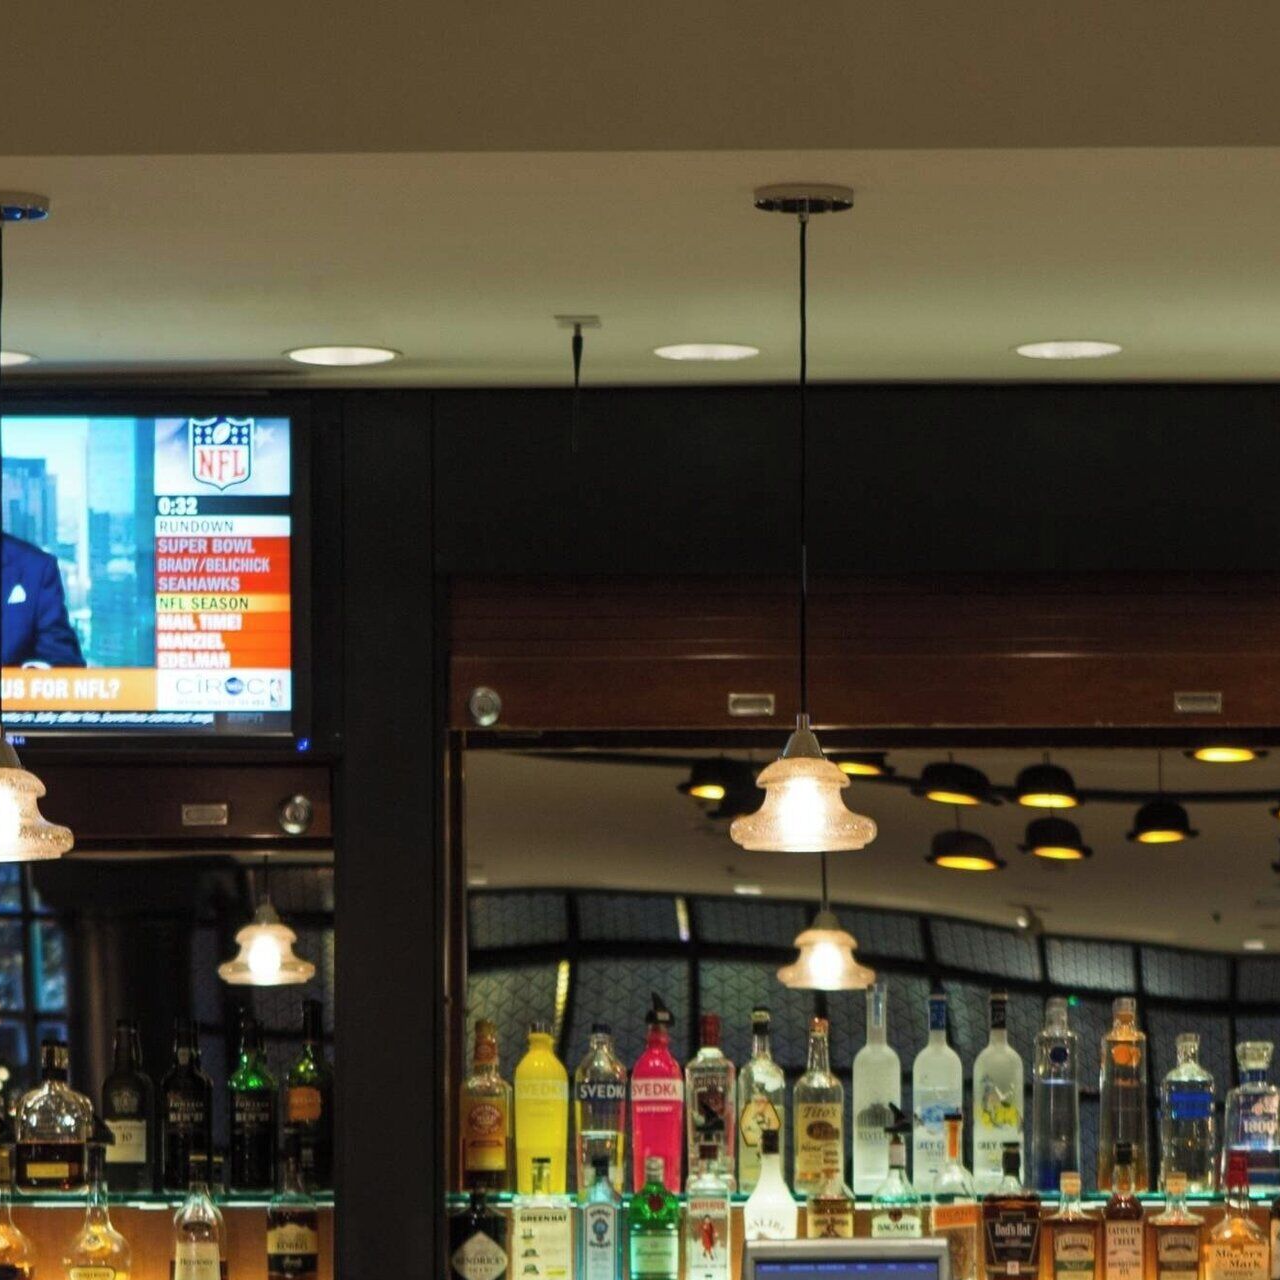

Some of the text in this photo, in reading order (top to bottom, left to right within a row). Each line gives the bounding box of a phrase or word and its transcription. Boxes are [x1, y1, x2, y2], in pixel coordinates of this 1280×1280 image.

[199, 449, 245, 482] NFL
[158, 496, 198, 515] 0:32
[159, 519, 234, 532] RUNDOWN
[158, 538, 256, 554] SUPER BOWL
[158, 557, 270, 573] BRADY/BELICHICK
[158, 576, 241, 592] SEAHAWKS
[159, 597, 249, 610] NFL SEASON
[157, 613, 197, 631] MAIL
[157, 651, 231, 669] EDELMAN
[30, 677, 68, 700] FOR
[74, 677, 120, 700] NFL?
[631, 1082, 678, 1097] SVEDKA
[802, 1105, 838, 1119] Tito's
[1244, 1120, 1277, 1134] 1800
[520, 1214, 568, 1223] GREEN HAT
[877, 1222, 916, 1232] BACARDI
[1229, 1260, 1261, 1269] Mark
